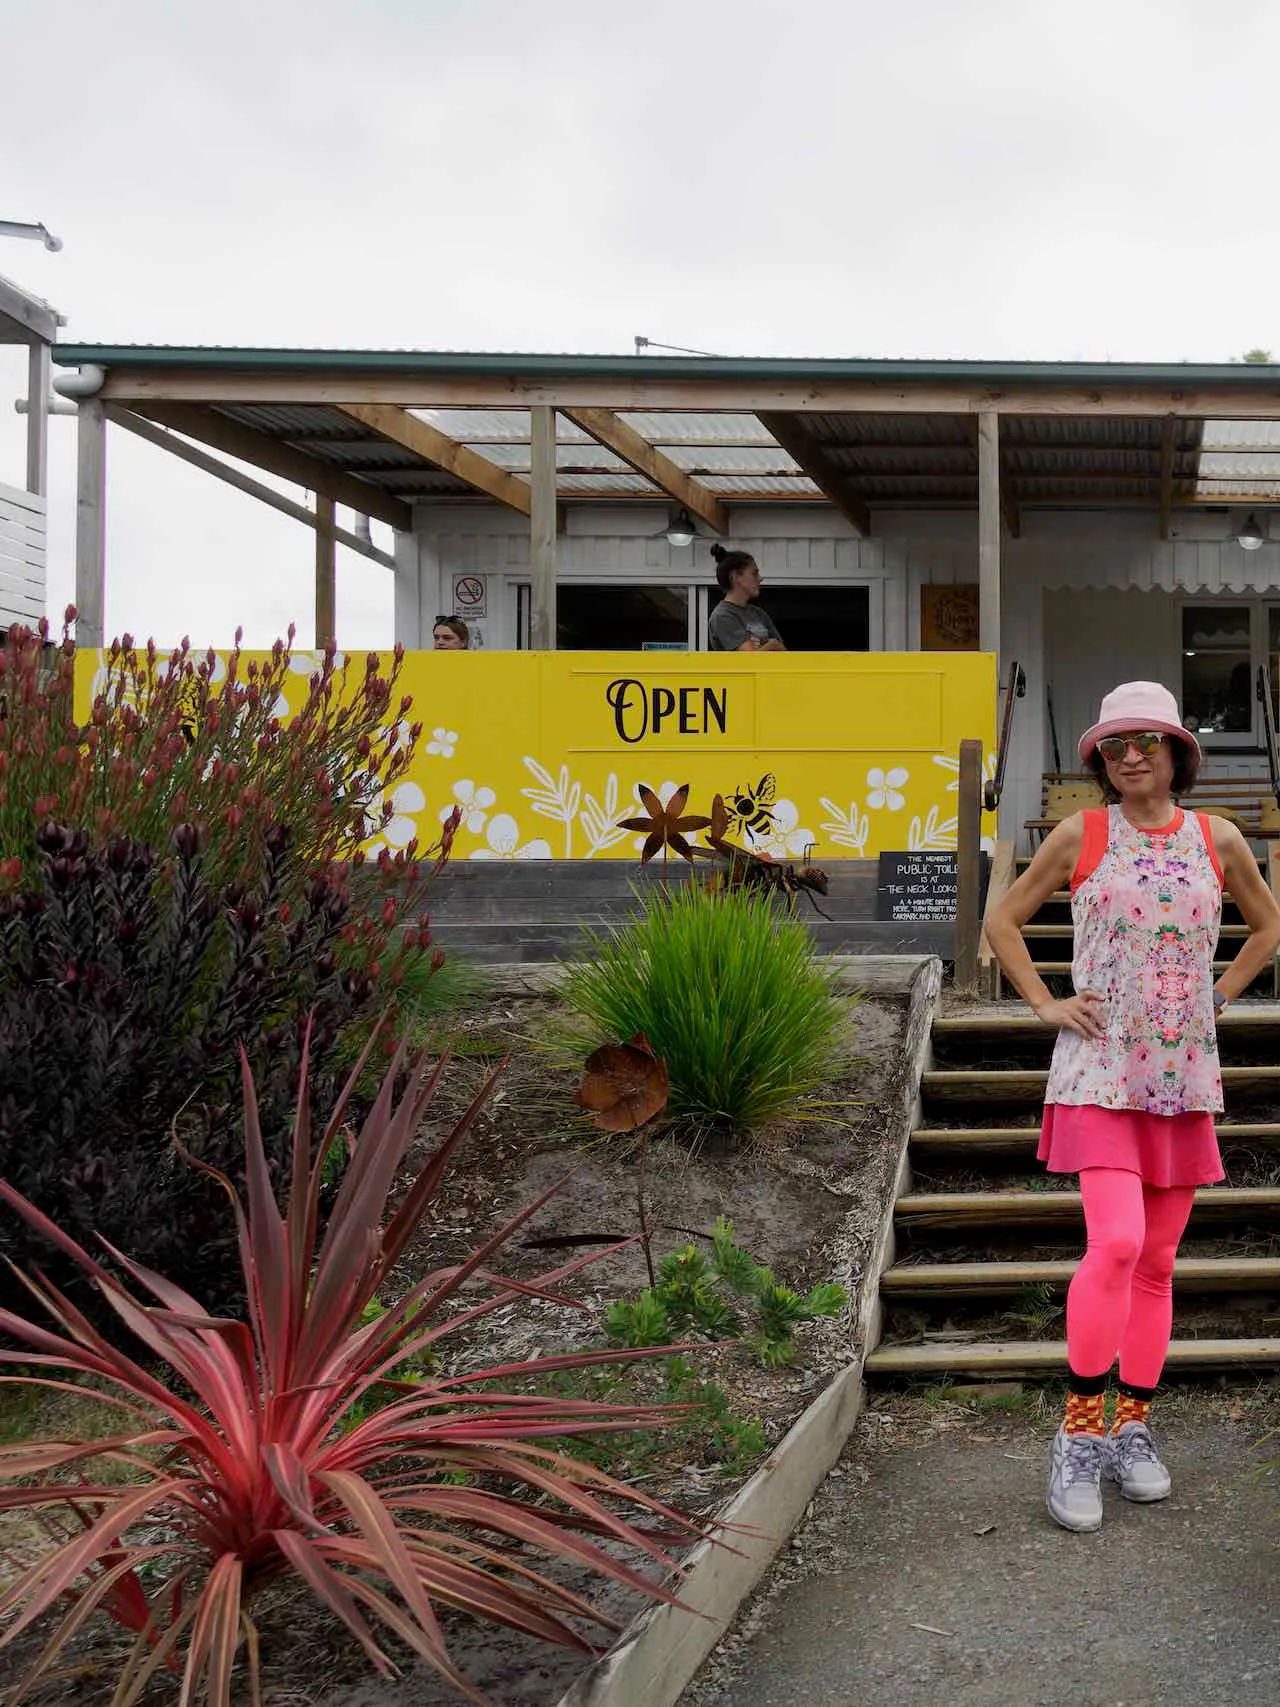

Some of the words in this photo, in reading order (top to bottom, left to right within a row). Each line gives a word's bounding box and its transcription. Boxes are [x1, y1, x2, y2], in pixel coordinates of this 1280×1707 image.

[607, 679, 727, 743] OPEN
[908, 855, 922, 863] THE
[925, 855, 953, 863] NEAREST
[896, 864, 932, 875] PUBLIC
[933, 864, 959, 875] TOILE
[930, 875, 939, 883] AT
[906, 884, 929, 894] NECK
[932, 884, 958, 894] LOOKO
[946, 905, 957, 913] FRO
